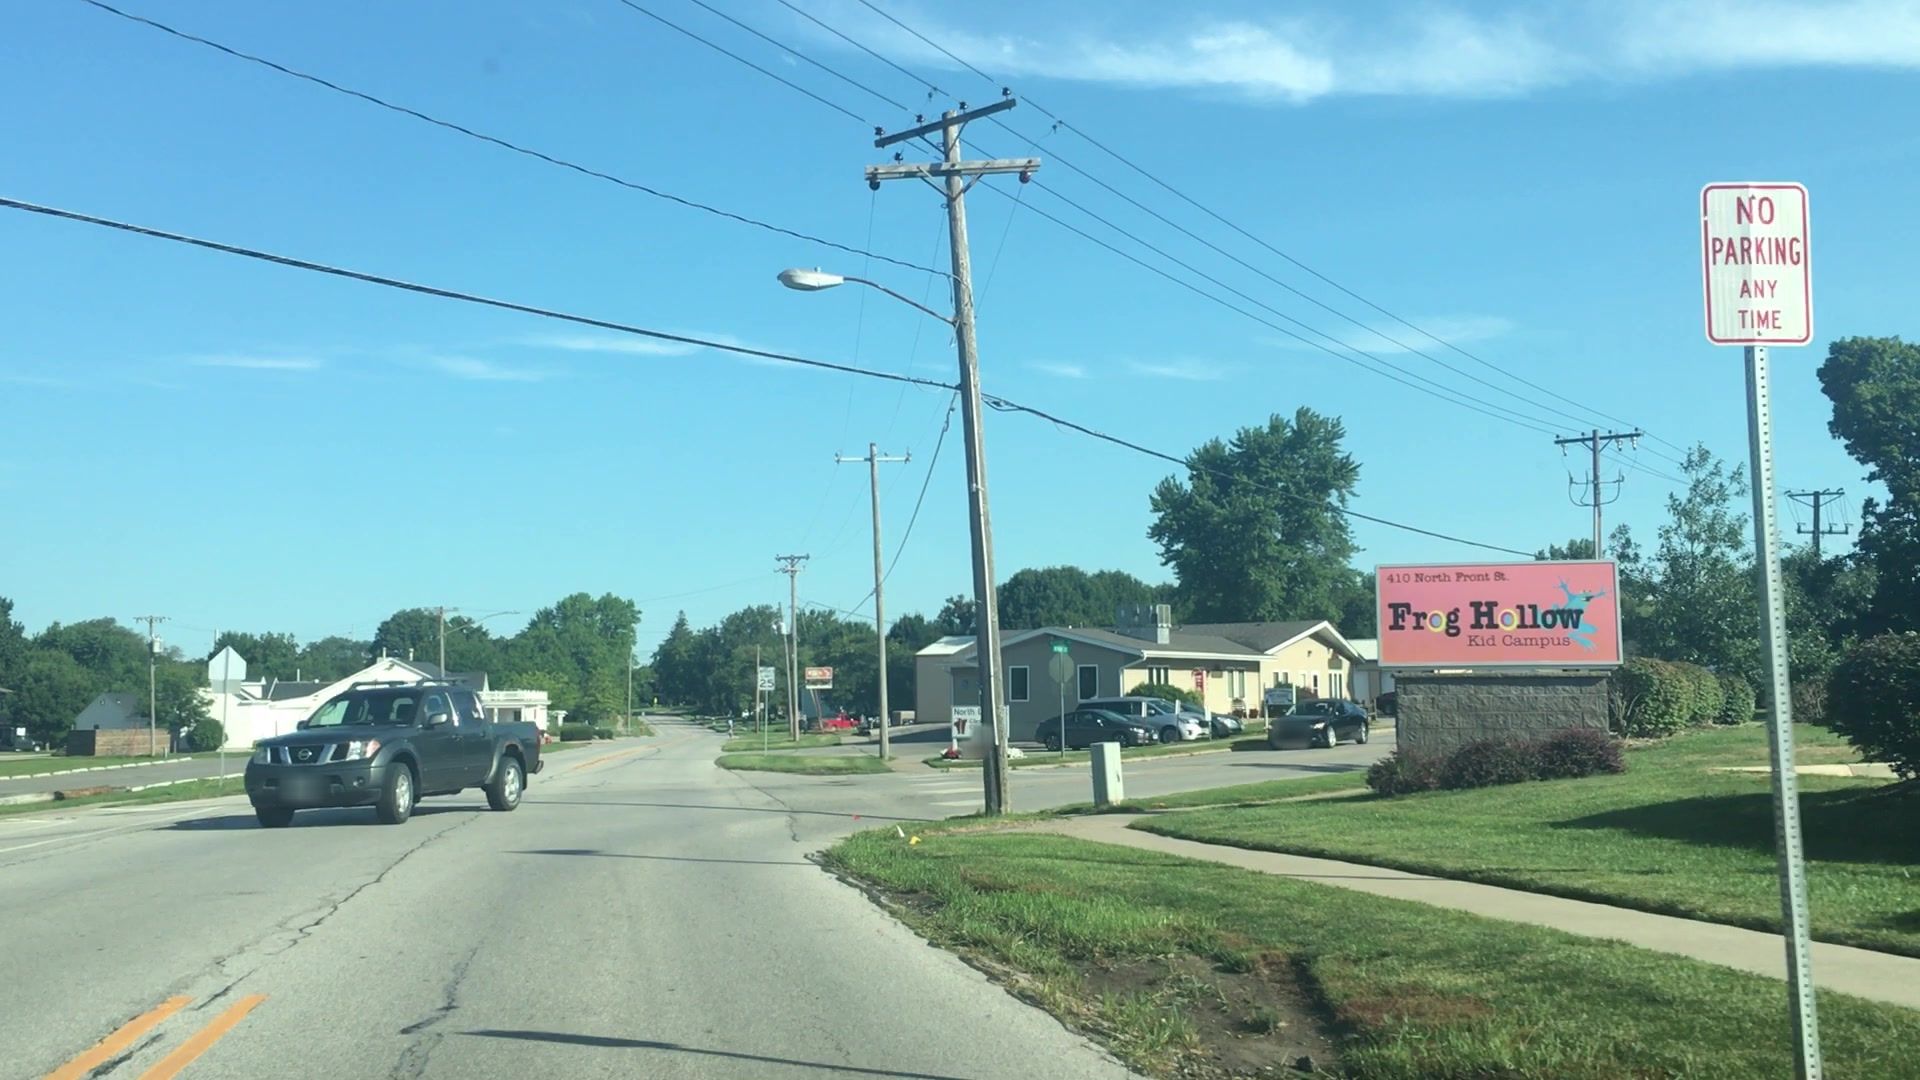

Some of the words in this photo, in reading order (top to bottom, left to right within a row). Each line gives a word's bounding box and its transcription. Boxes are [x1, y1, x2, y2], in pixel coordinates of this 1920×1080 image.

[1736, 196, 1775, 225] NO
[1711, 237, 1801, 265] PARKING
[1739, 279, 1777, 298] ANY
[1738, 310, 1782, 329] TIME
[1386, 573, 1411, 583] 410
[1414, 573, 1451, 583] North
[1455, 572, 1490, 582] Front
[1493, 571, 1510, 582] St.
[1388, 602, 1461, 637] Frog
[1469, 601, 1584, 632] Hollow
[1467, 634, 1497, 647] Kid
[1502, 634, 1571, 648] Campus
[760, 678, 775, 688] 25
